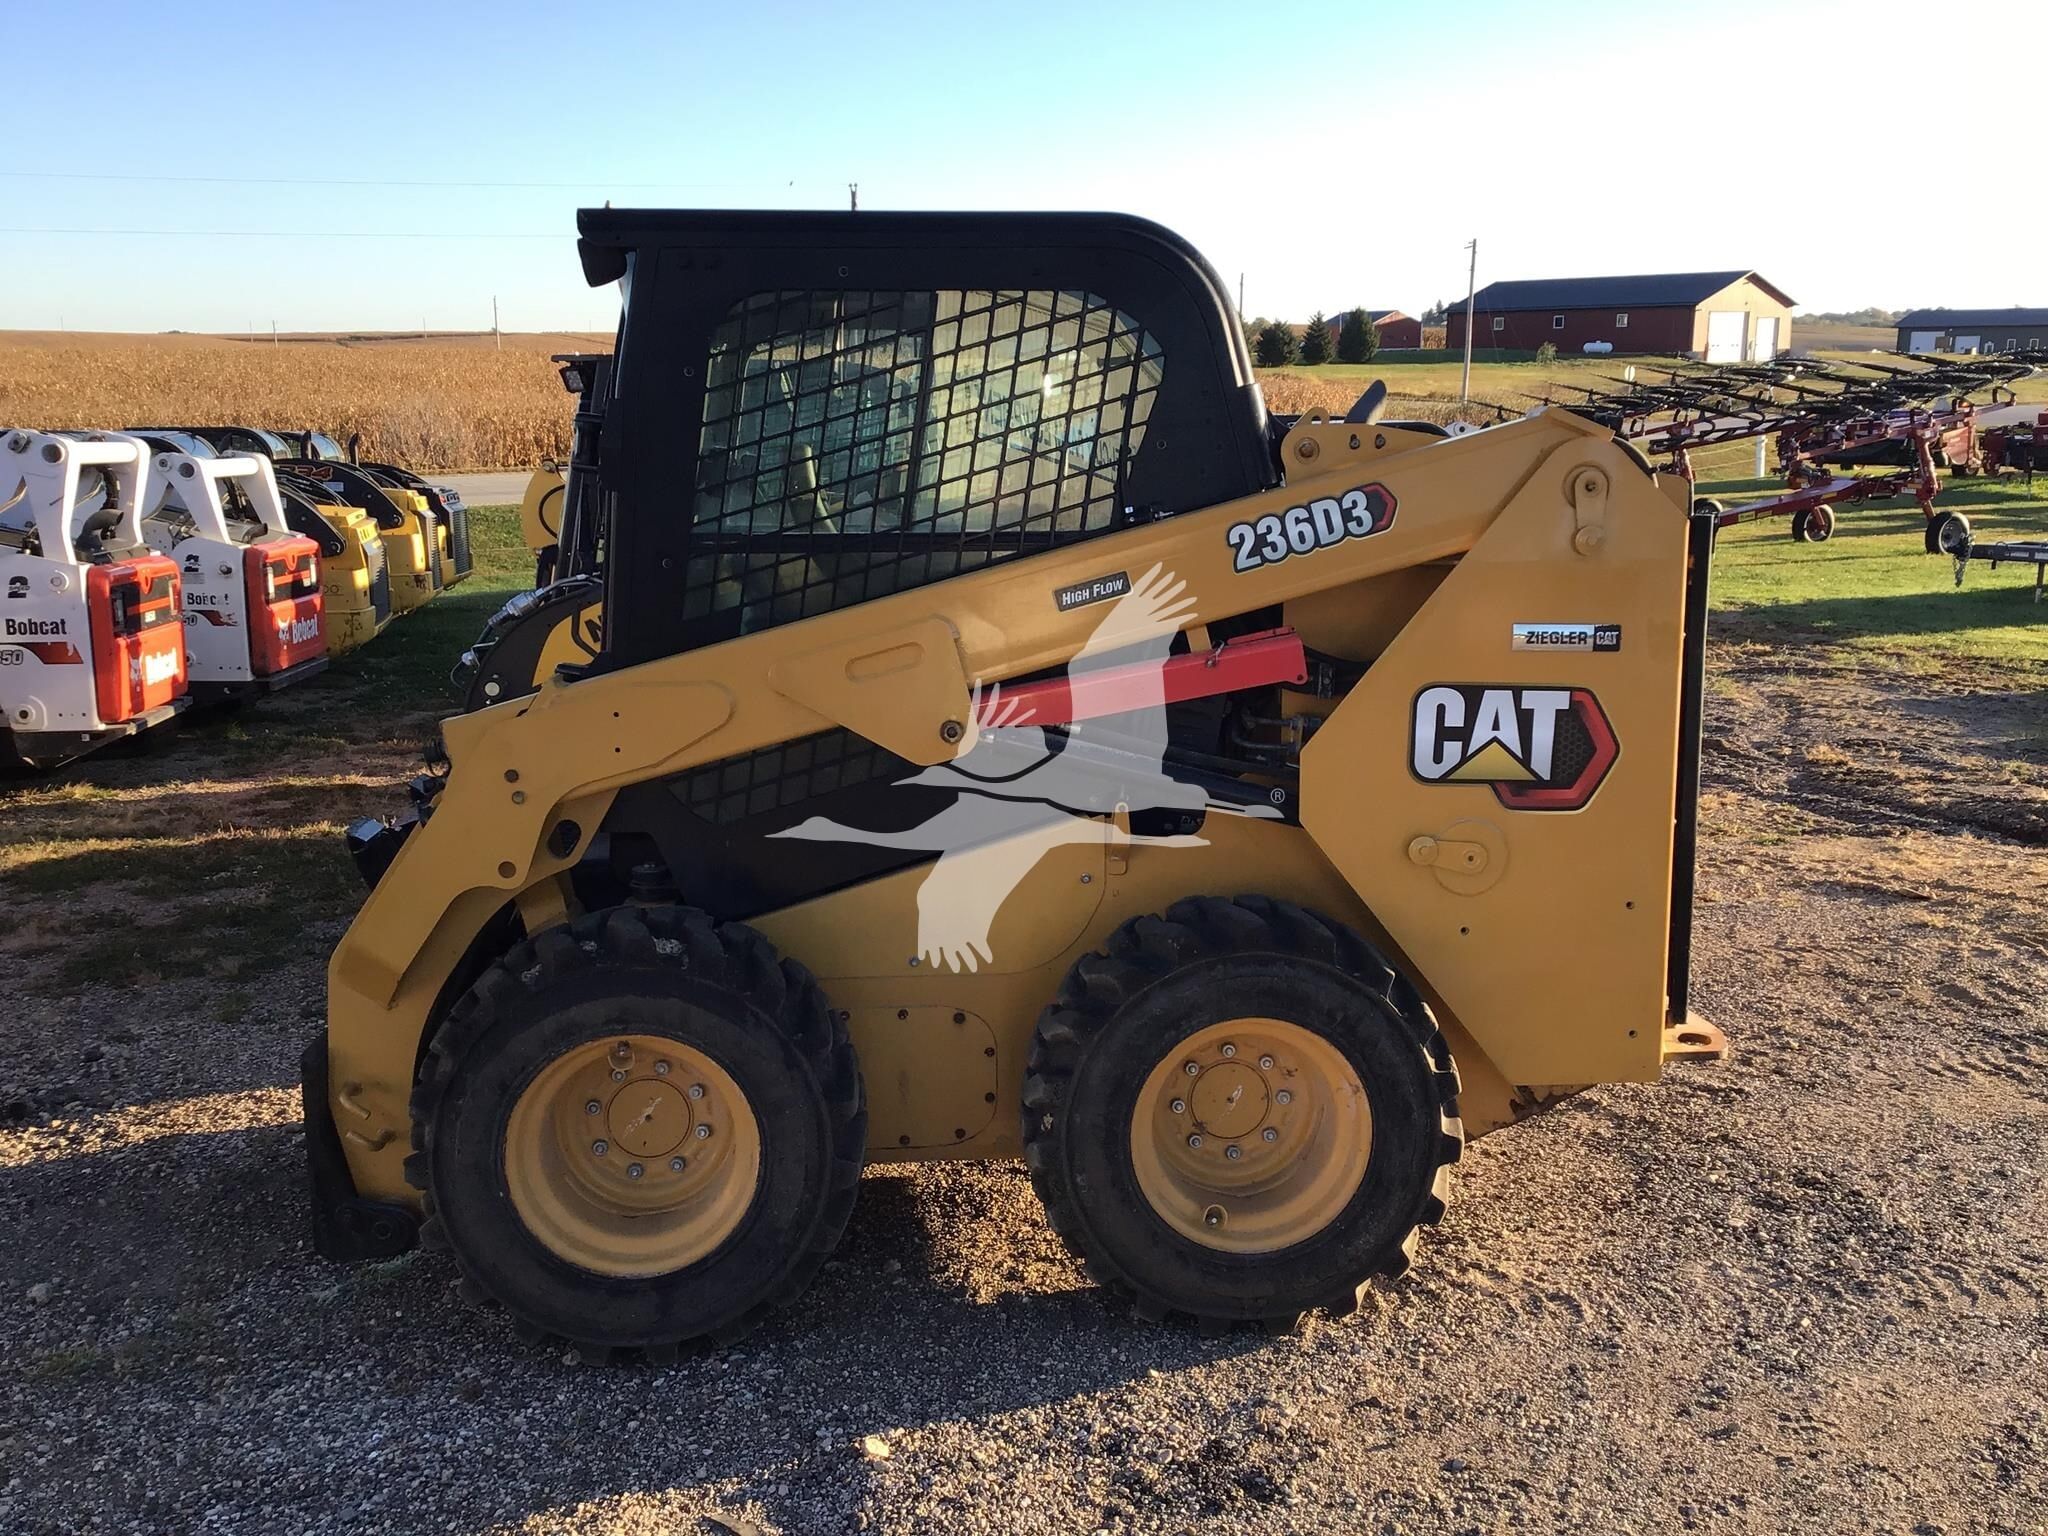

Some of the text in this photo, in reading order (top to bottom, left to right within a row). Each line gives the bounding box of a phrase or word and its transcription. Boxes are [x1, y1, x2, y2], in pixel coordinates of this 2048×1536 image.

[1229, 490, 1373, 570] 236D3
[8, 576, 28, 598] 2
[5, 618, 67, 636] Bobcat
[292, 613, 318, 645] Bobcat
[1526, 631, 1619, 645] ZIEGLER CAT
[0, 649, 24, 666] 50
[1414, 687, 1571, 781] CAT
